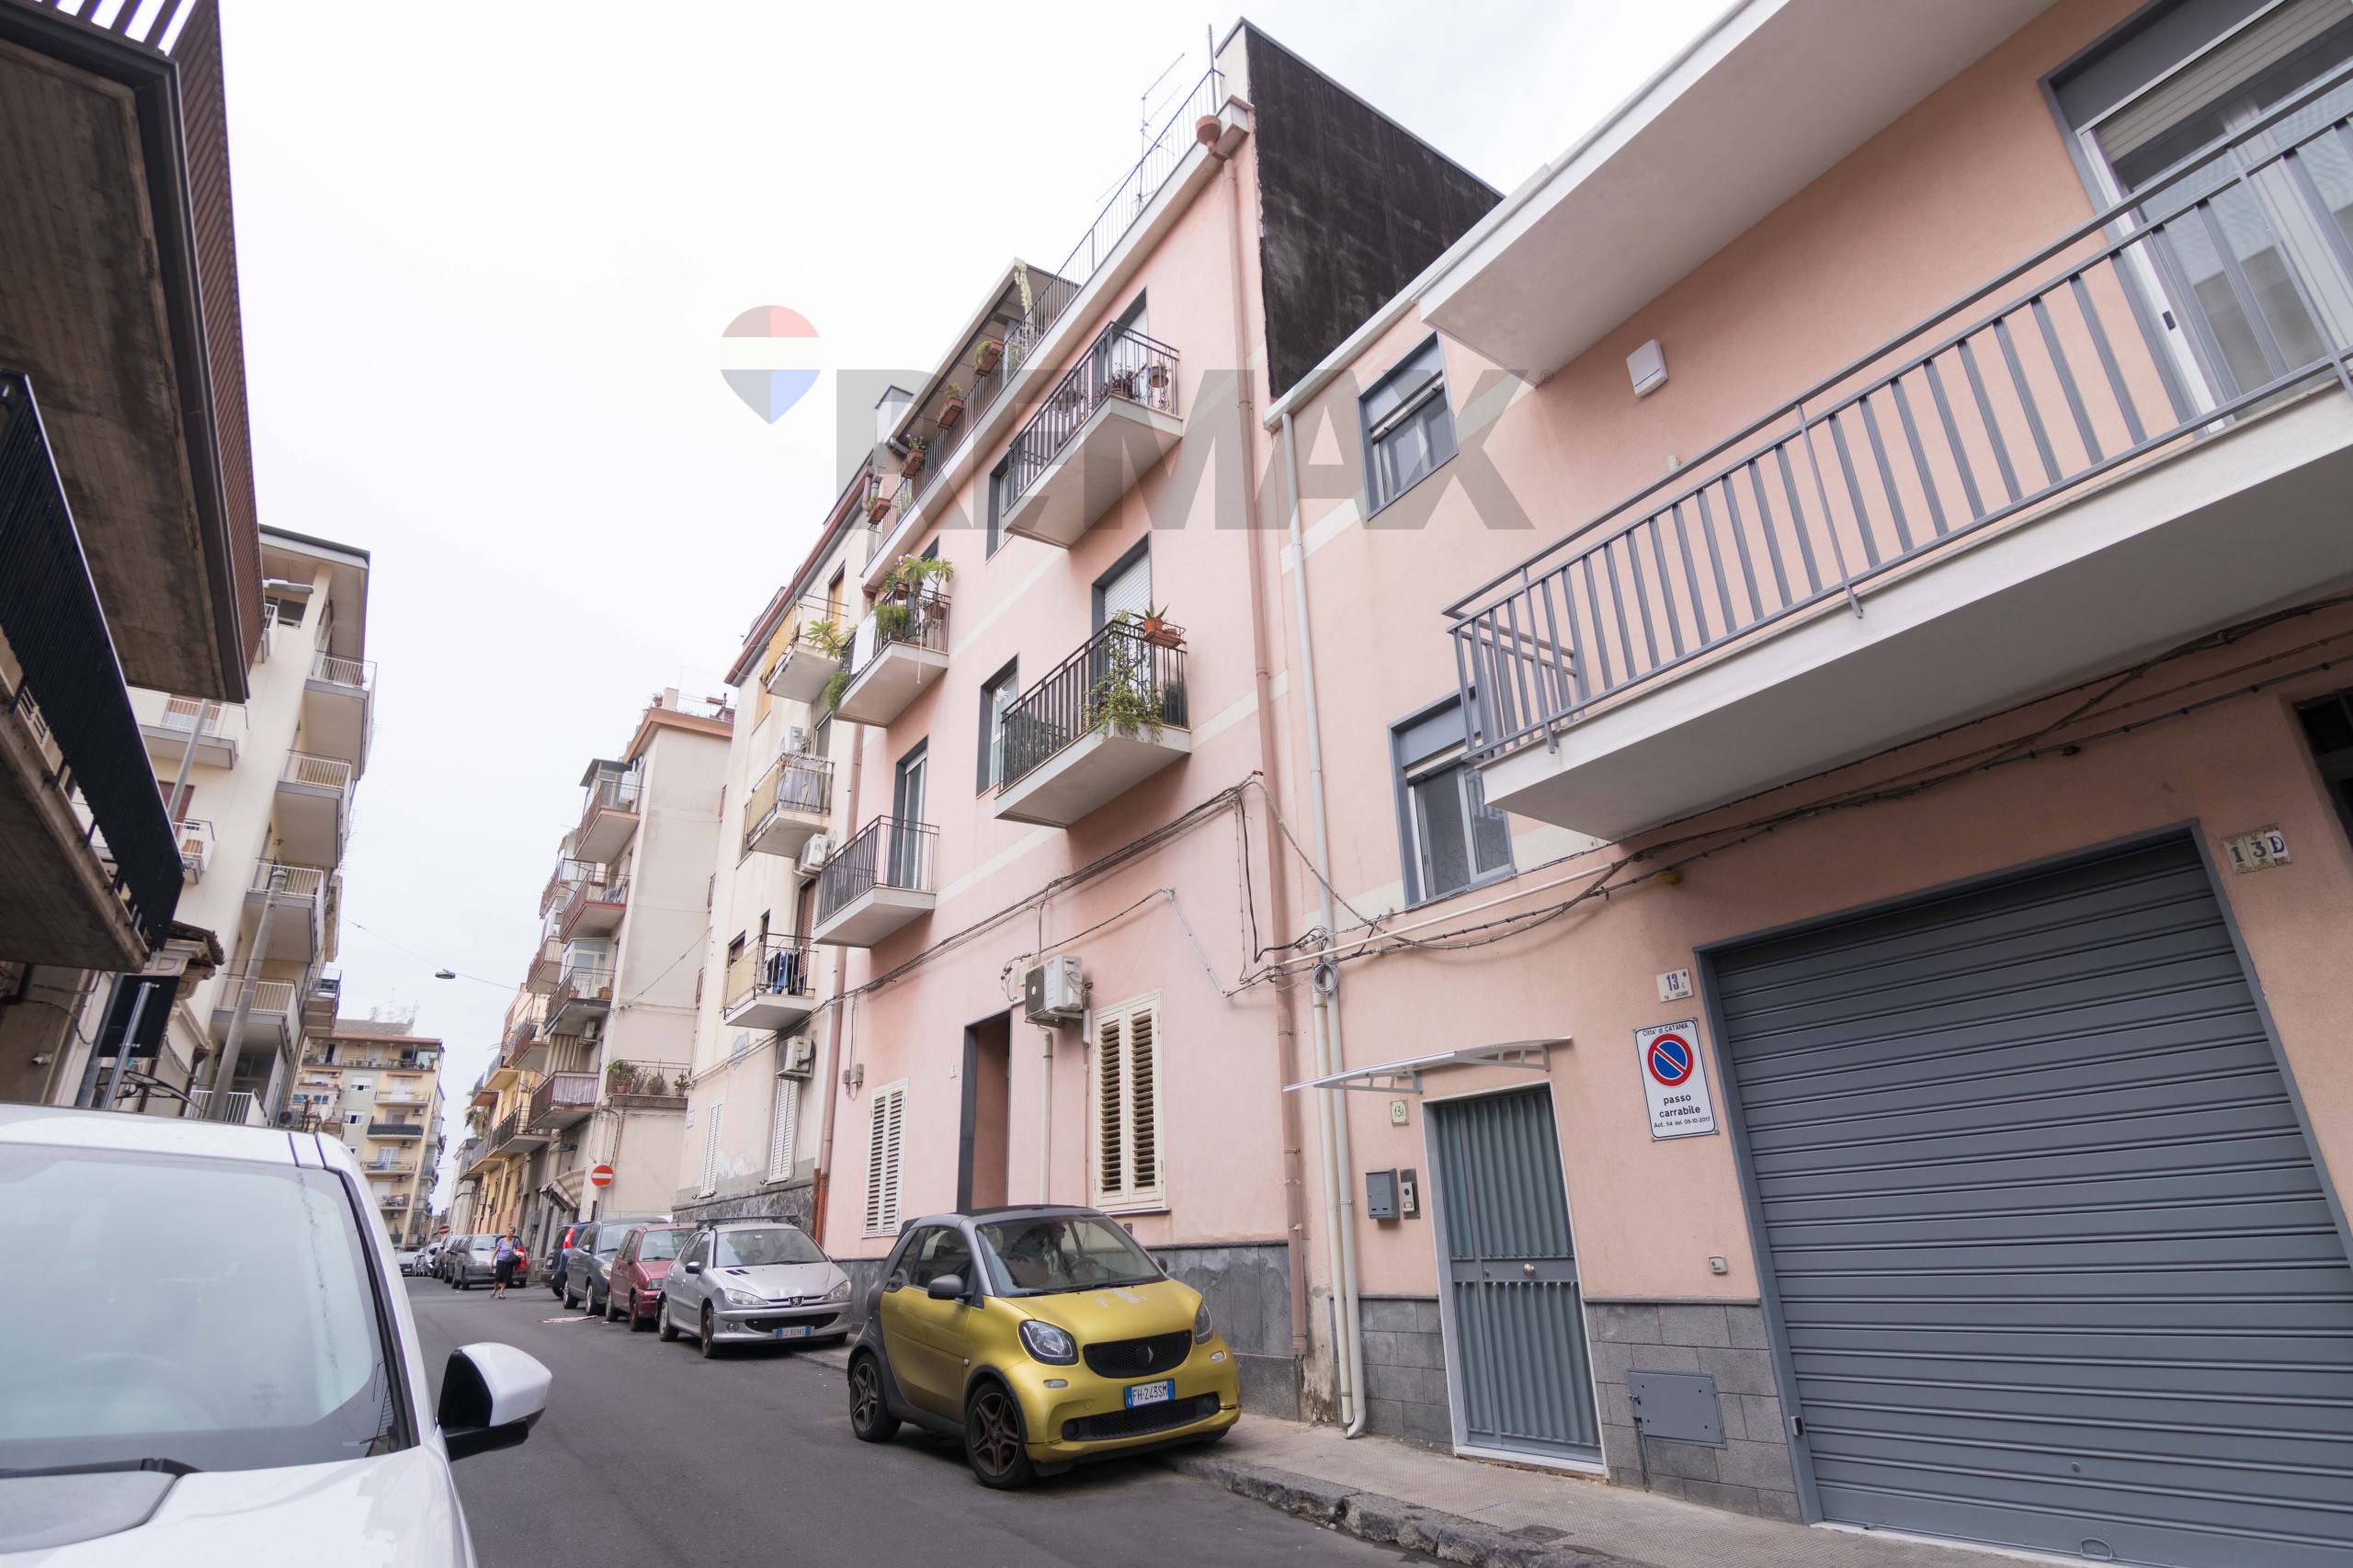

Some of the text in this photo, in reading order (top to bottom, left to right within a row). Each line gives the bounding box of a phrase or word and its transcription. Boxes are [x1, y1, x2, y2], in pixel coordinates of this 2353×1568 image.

[2230, 835, 2285, 863] 13D
[1665, 972, 1679, 992] 13
[1665, 1022, 1688, 1032] CATANIA
[1663, 1094, 1691, 1107] passo
[1659, 1105, 1700, 1119] carrabile
